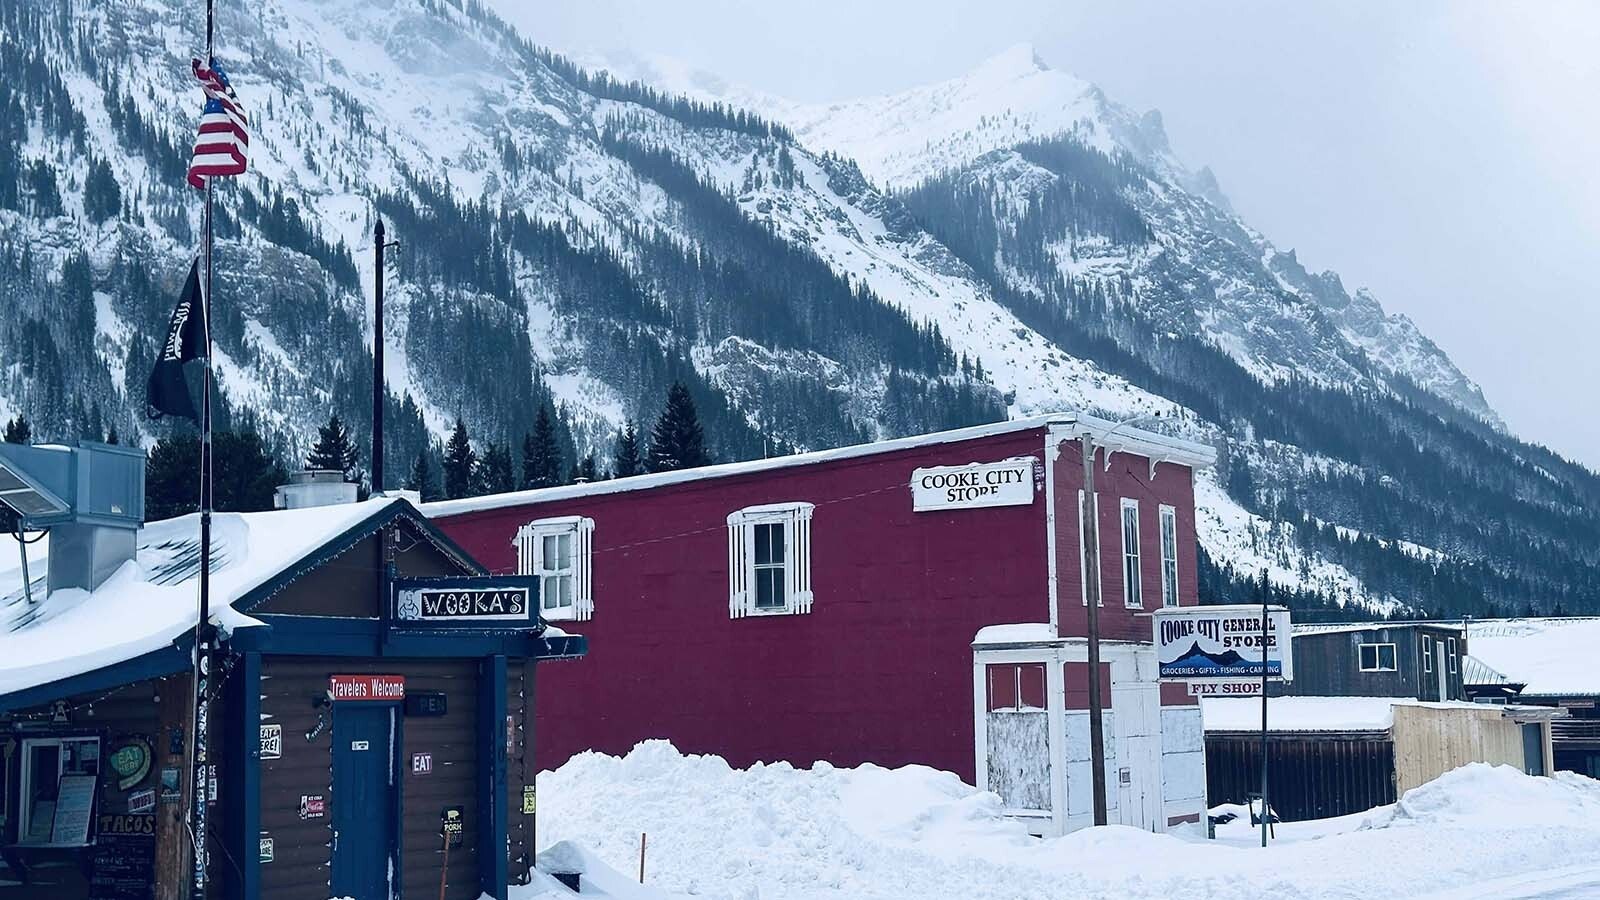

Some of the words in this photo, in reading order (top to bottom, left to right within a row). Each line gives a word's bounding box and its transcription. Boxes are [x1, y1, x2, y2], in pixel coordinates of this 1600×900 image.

[922, 472, 979, 489] COOKE
[986, 469, 1025, 485] CITY
[423, 592, 522, 615] WOOKA'S
[1160, 620, 1194, 646] COOKE
[1197, 619, 1220, 642] CITY
[1223, 635, 1276, 647] STORE
[1161, 667, 1195, 675] GROCERIES
[1249, 666, 1280, 674] CAMING
[331, 678, 367, 697] Travelers
[371, 678, 404, 697] Welcome
[1191, 683, 1218, 694] FLY
[1222, 683, 1262, 694] SHOP
[413, 755, 432, 773] EAT
[100, 815, 155, 834] TACOS
[444, 823, 463, 832] PORK
